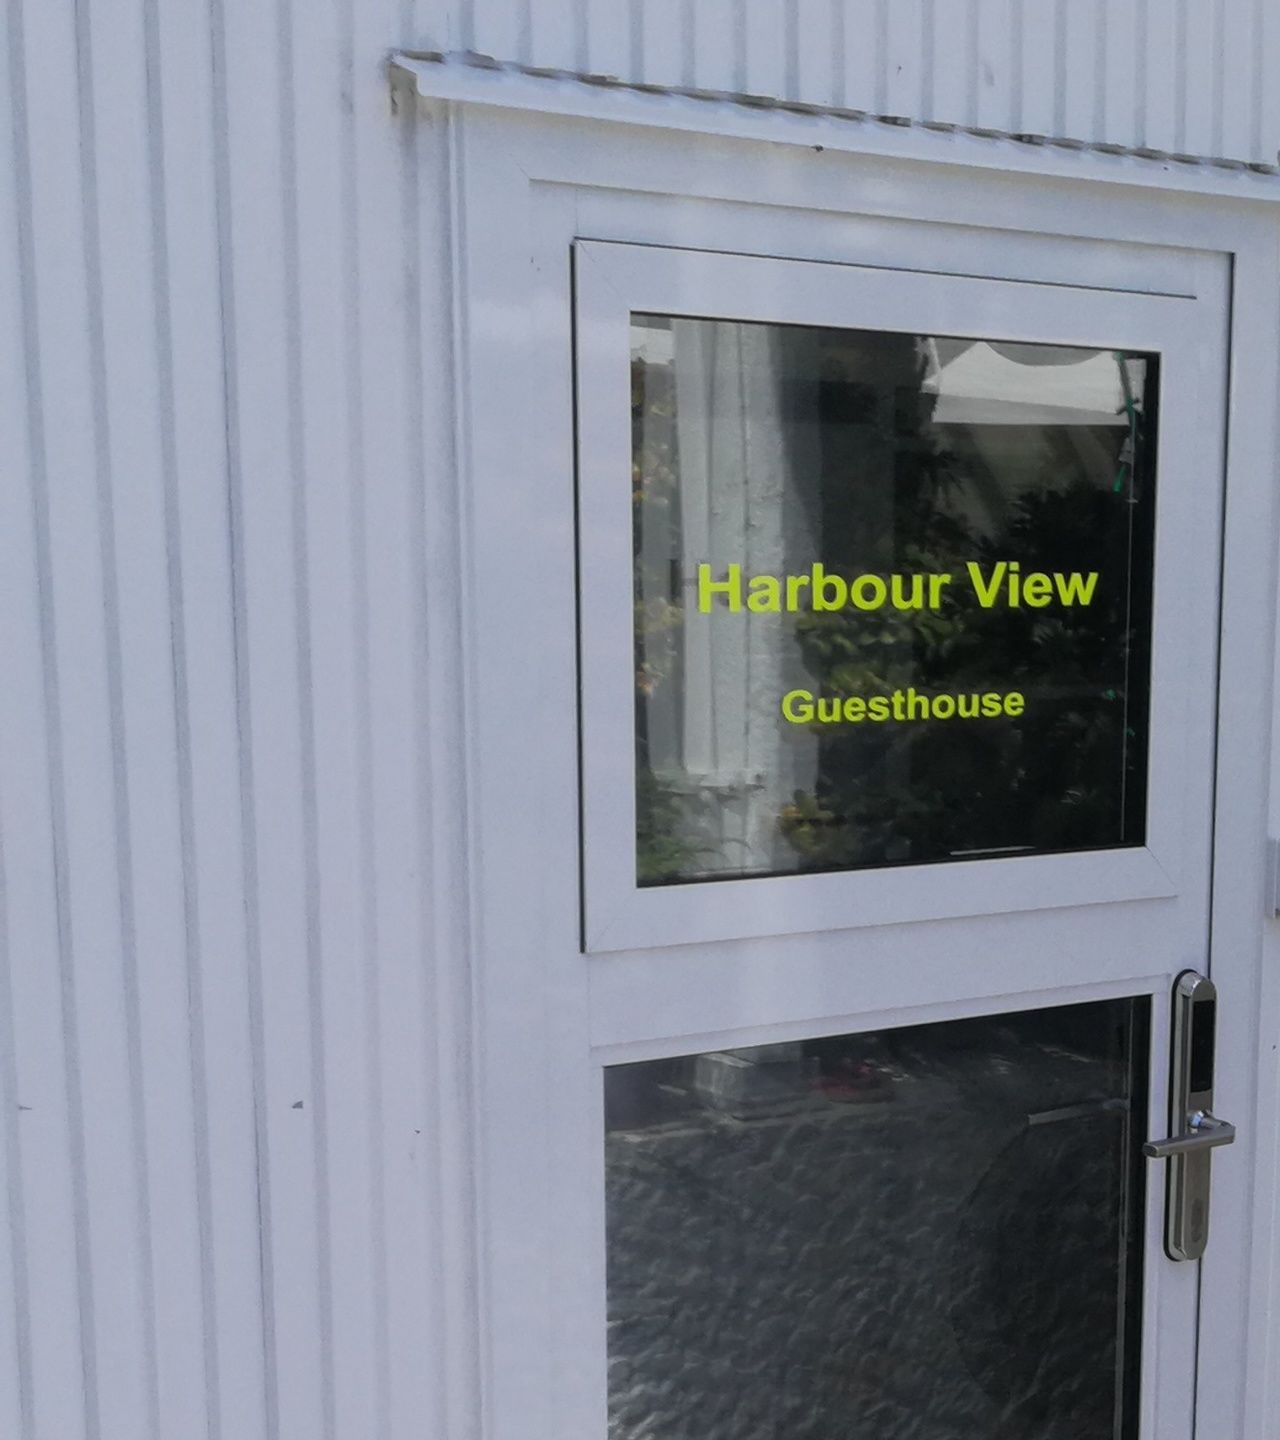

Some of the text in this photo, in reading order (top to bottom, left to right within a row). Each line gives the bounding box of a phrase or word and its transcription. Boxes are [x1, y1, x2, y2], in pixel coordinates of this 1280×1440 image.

[697, 560, 1099, 614] Harbour View
[781, 687, 1025, 725] Guesthouse
